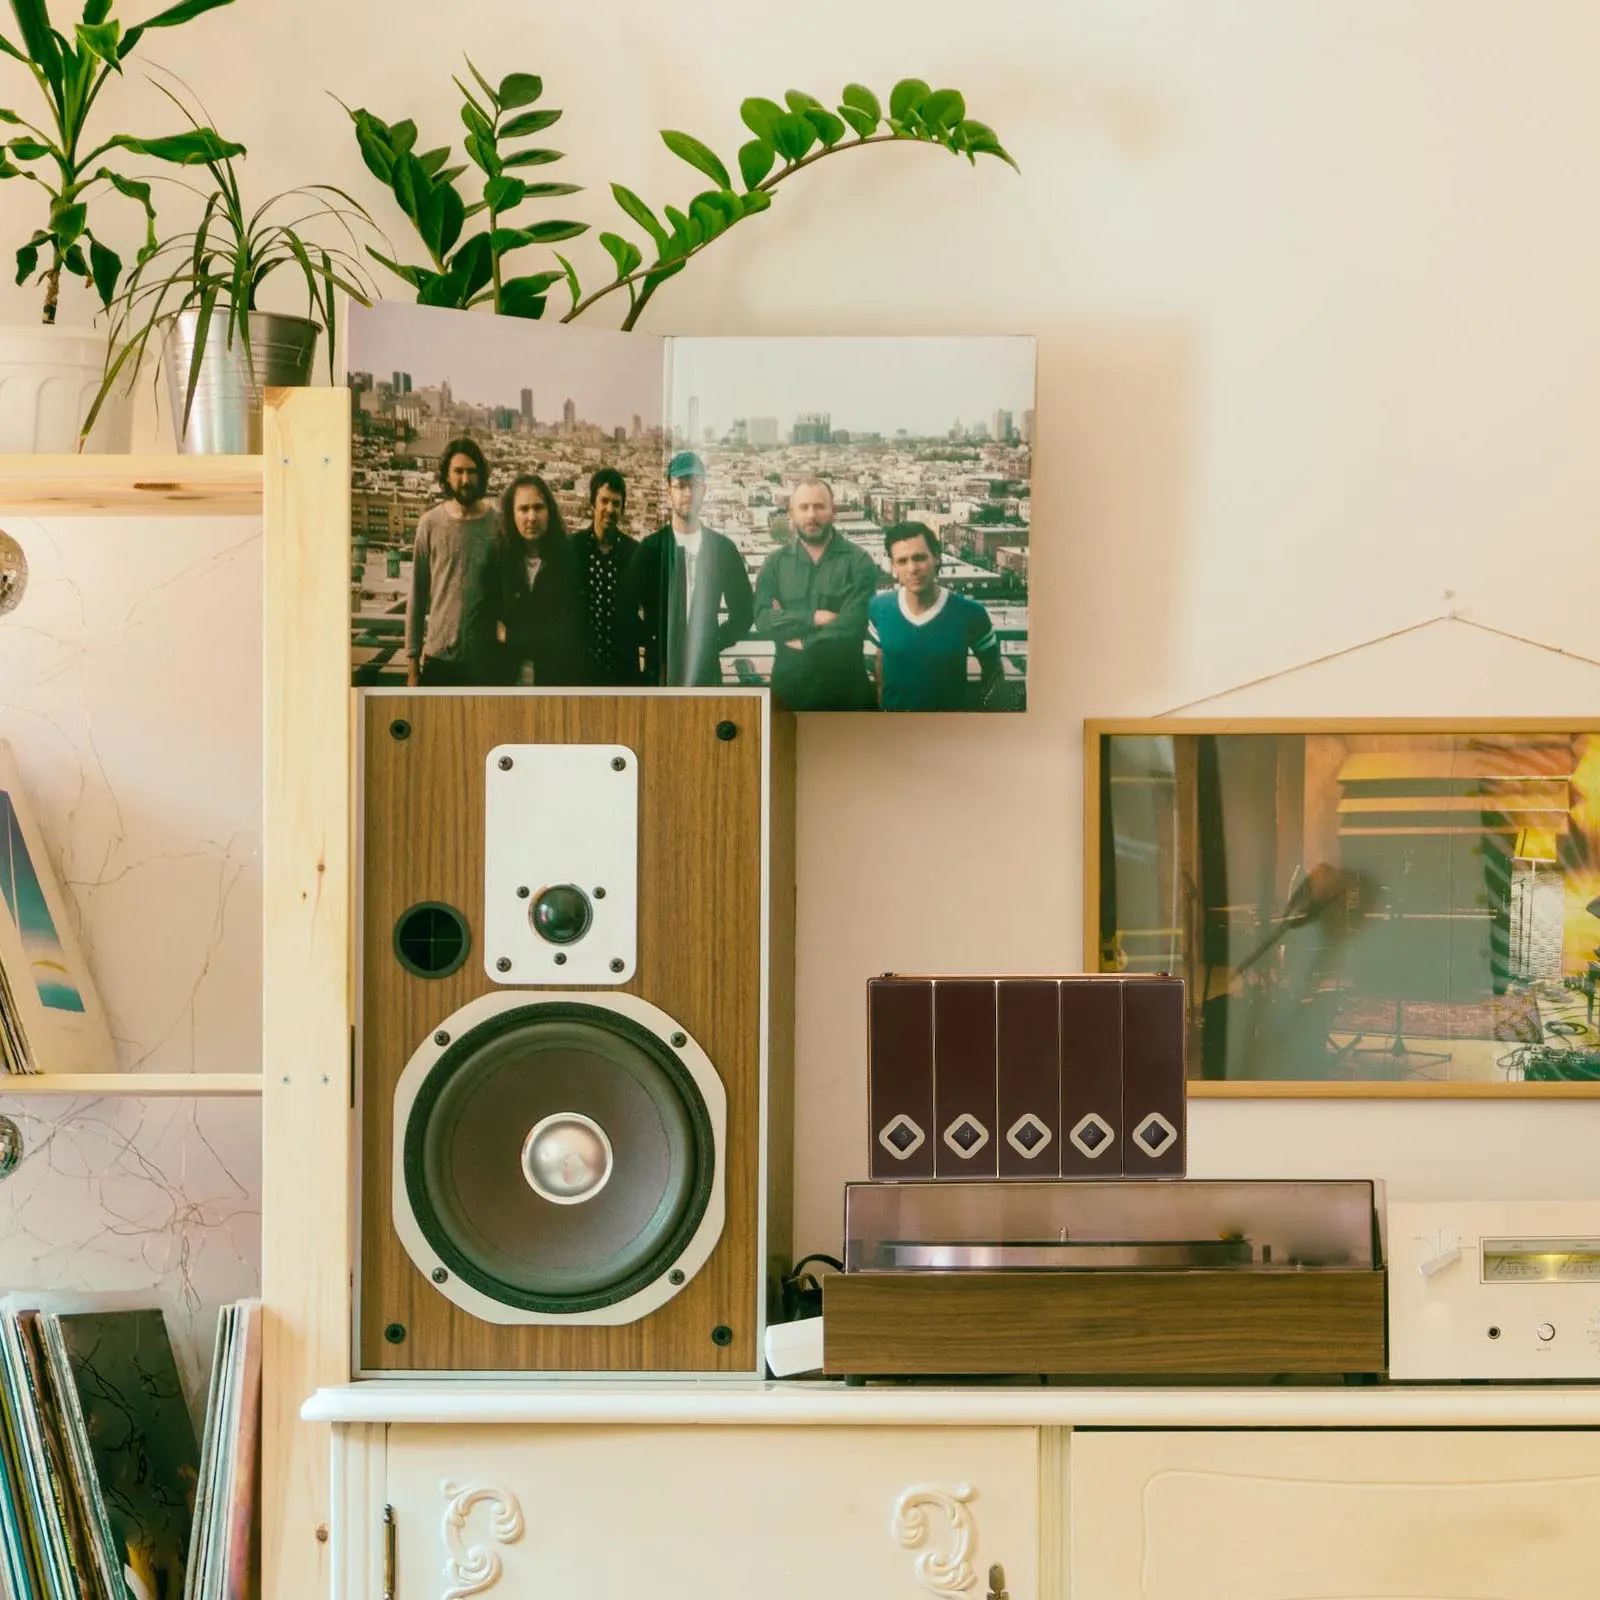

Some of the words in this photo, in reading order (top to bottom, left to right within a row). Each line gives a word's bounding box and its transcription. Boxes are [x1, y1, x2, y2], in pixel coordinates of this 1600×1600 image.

[901, 1130, 908, 1140] 5
[964, 1129, 971, 1140] 4
[1025, 1129, 1031, 1140] 3
[1088, 1128, 1094, 1139] 2
